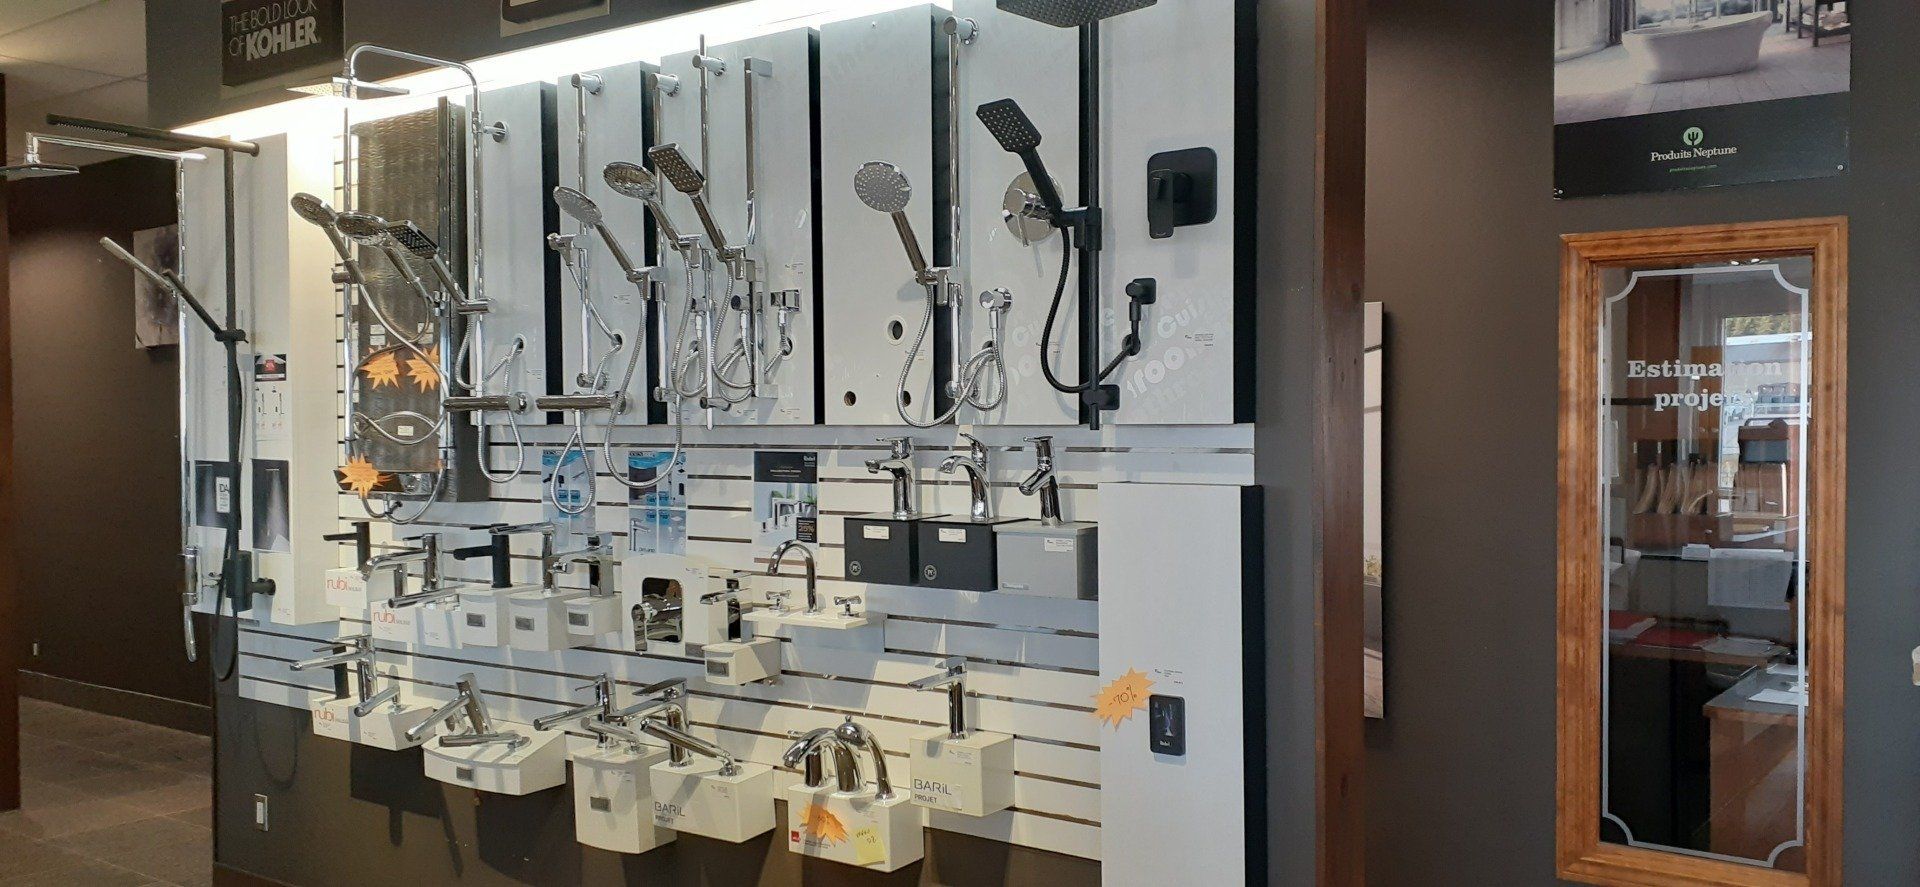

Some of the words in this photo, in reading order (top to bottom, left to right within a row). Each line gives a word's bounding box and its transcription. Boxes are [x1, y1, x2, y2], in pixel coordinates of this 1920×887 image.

[229, 11, 249, 33] THE
[250, 3, 281, 28] BOLD
[283, 0, 317, 19] LOOK
[229, 35, 245, 56] OF
[245, 16, 320, 61] KOHLER
[1651, 150, 1692, 161] Produits
[1692, 146, 1738, 158] Neptune
[1627, 358, 1783, 378] Estimaion
[326, 577, 349, 591] rubi
[373, 609, 396, 624] rubi
[1108, 684, 1137, 706] -70%
[314, 707, 335, 722] rubi
[914, 793, 937, 803] PROJET
